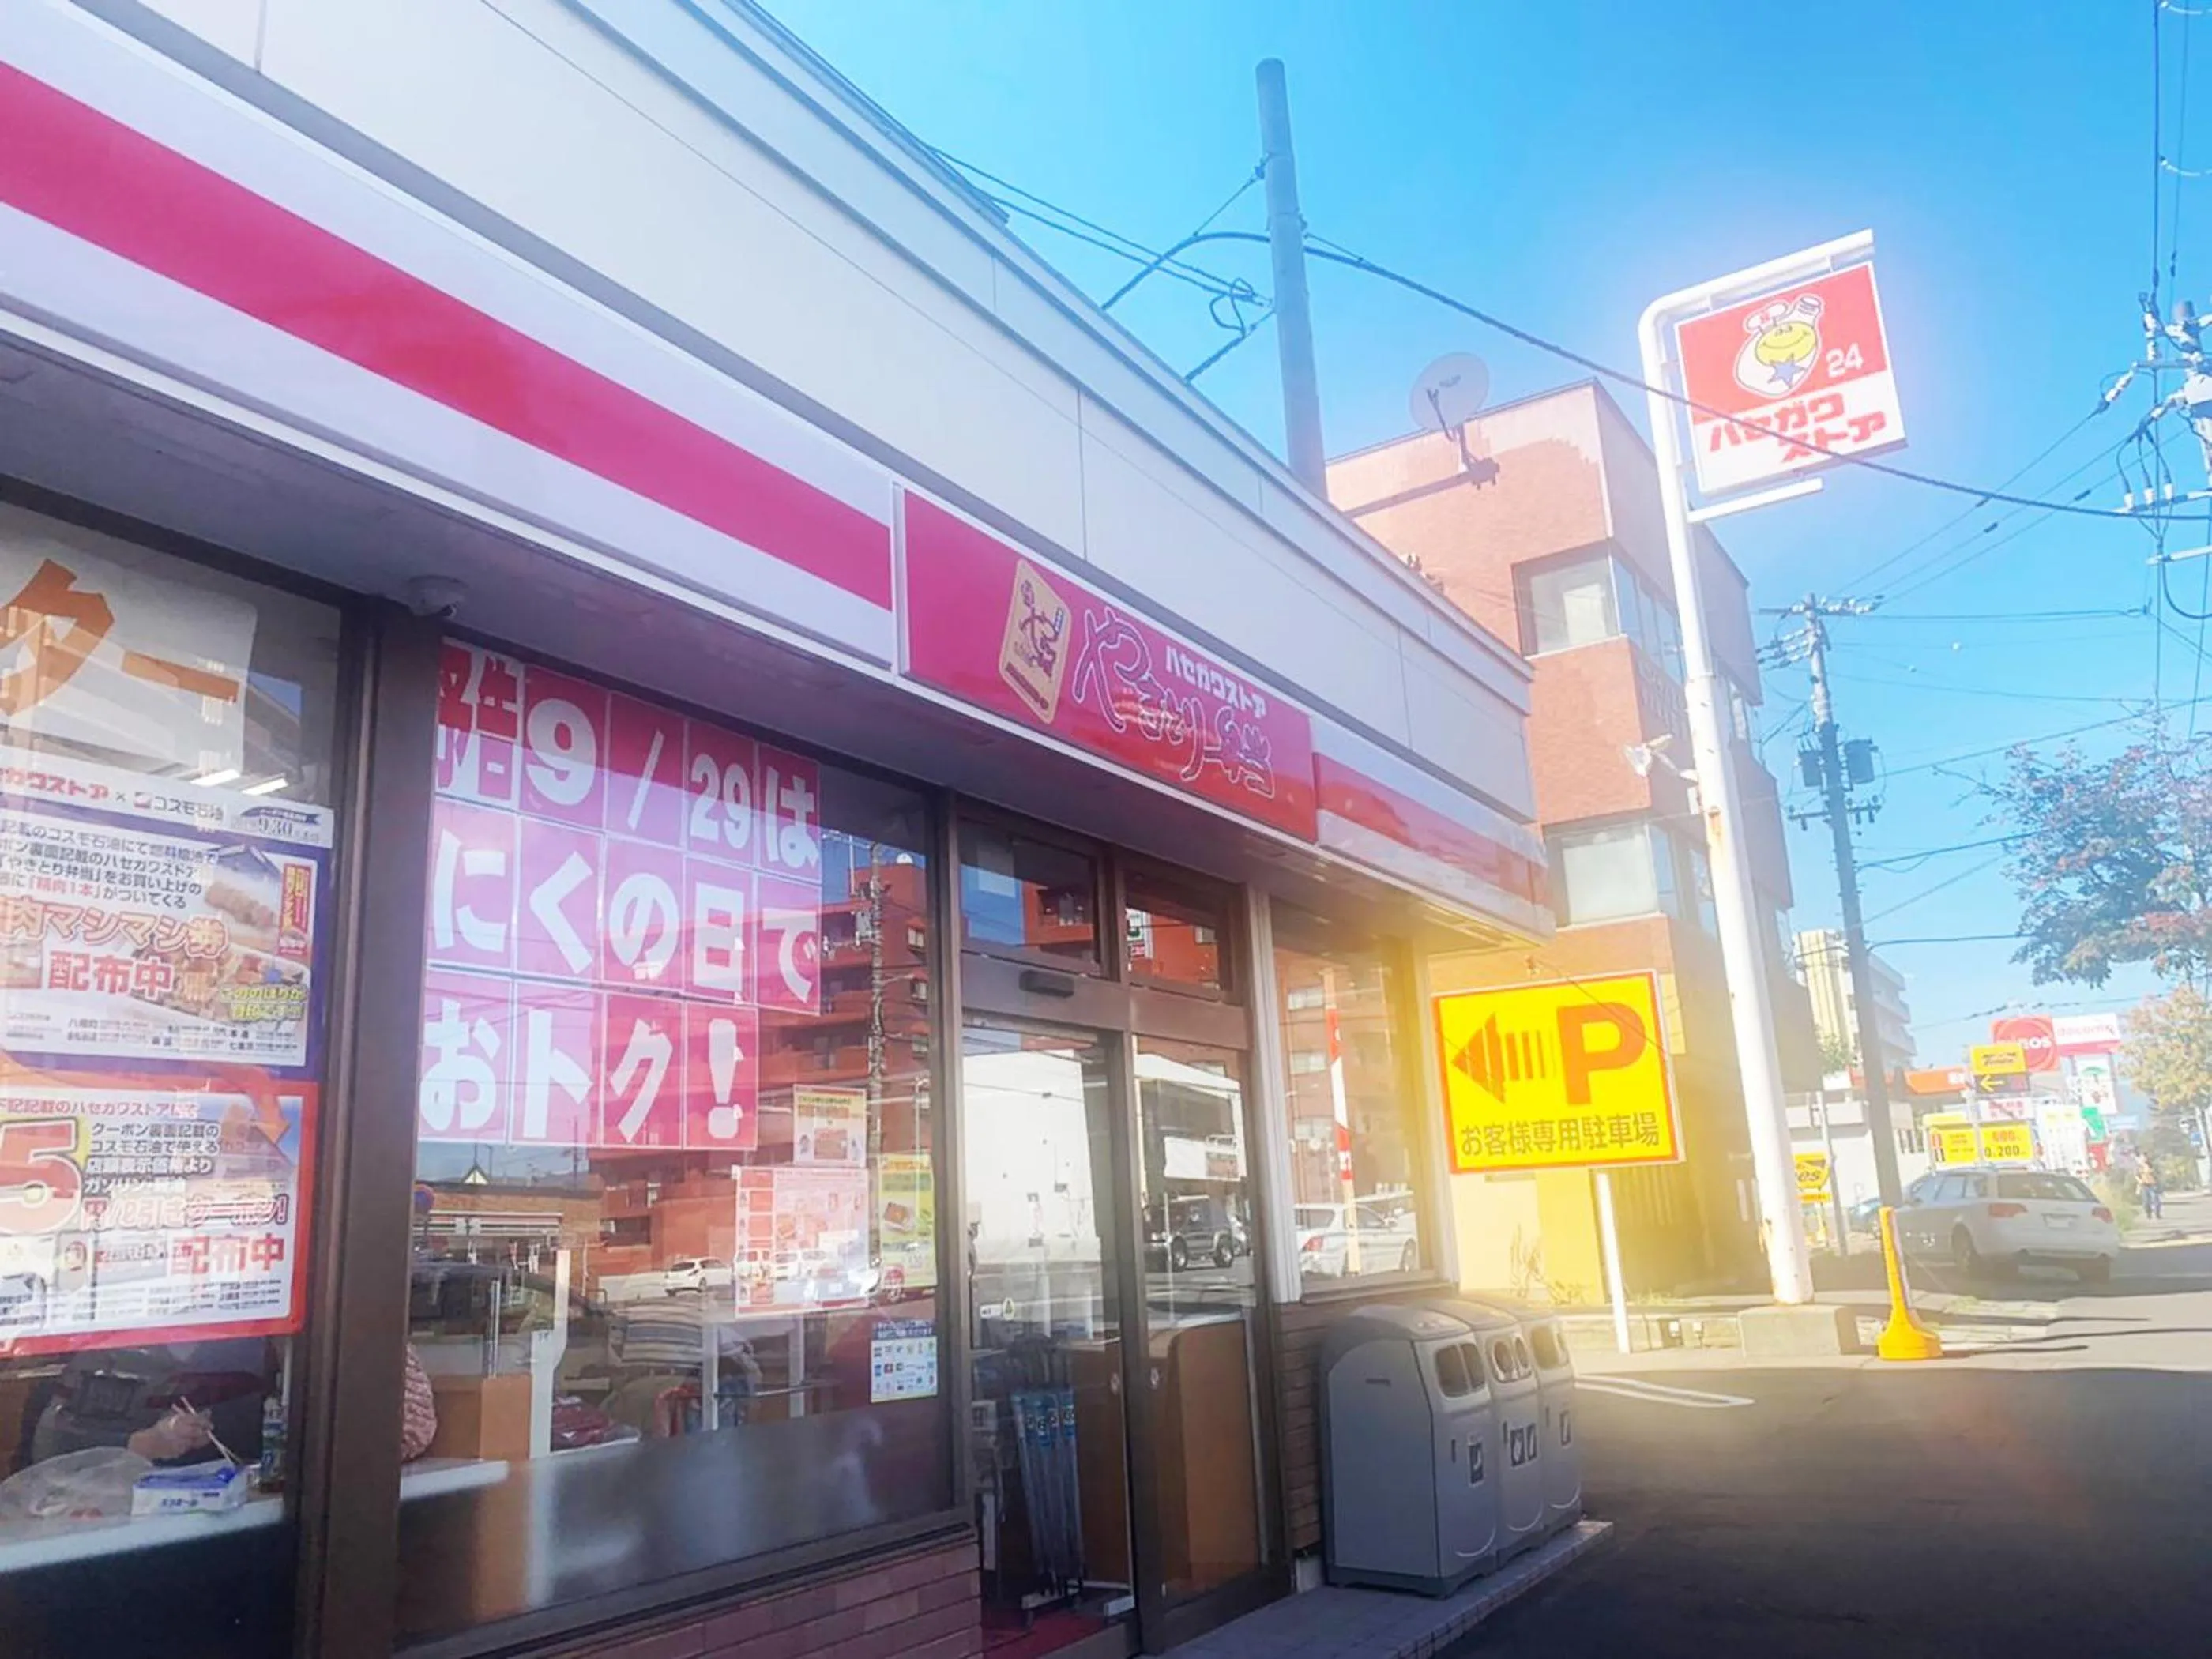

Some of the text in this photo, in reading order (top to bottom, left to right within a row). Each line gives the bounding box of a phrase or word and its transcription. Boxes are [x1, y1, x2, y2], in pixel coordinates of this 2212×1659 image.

[1826, 343, 1864, 378] 24
[1710, 393, 1845, 453] ハセガワ
[1780, 410, 1887, 463] ストア
[1165, 645, 1267, 719] ハセガワストア
[0, 767, 110, 800] ガワストア
[433, 828, 818, 1003] にくの日で
[48, 950, 173, 999] 配布中
[1556, 1001, 1646, 1106] P
[1461, 1111, 1660, 1157] お客様専用駐車場
[0, 1118, 81, 1236] 5
